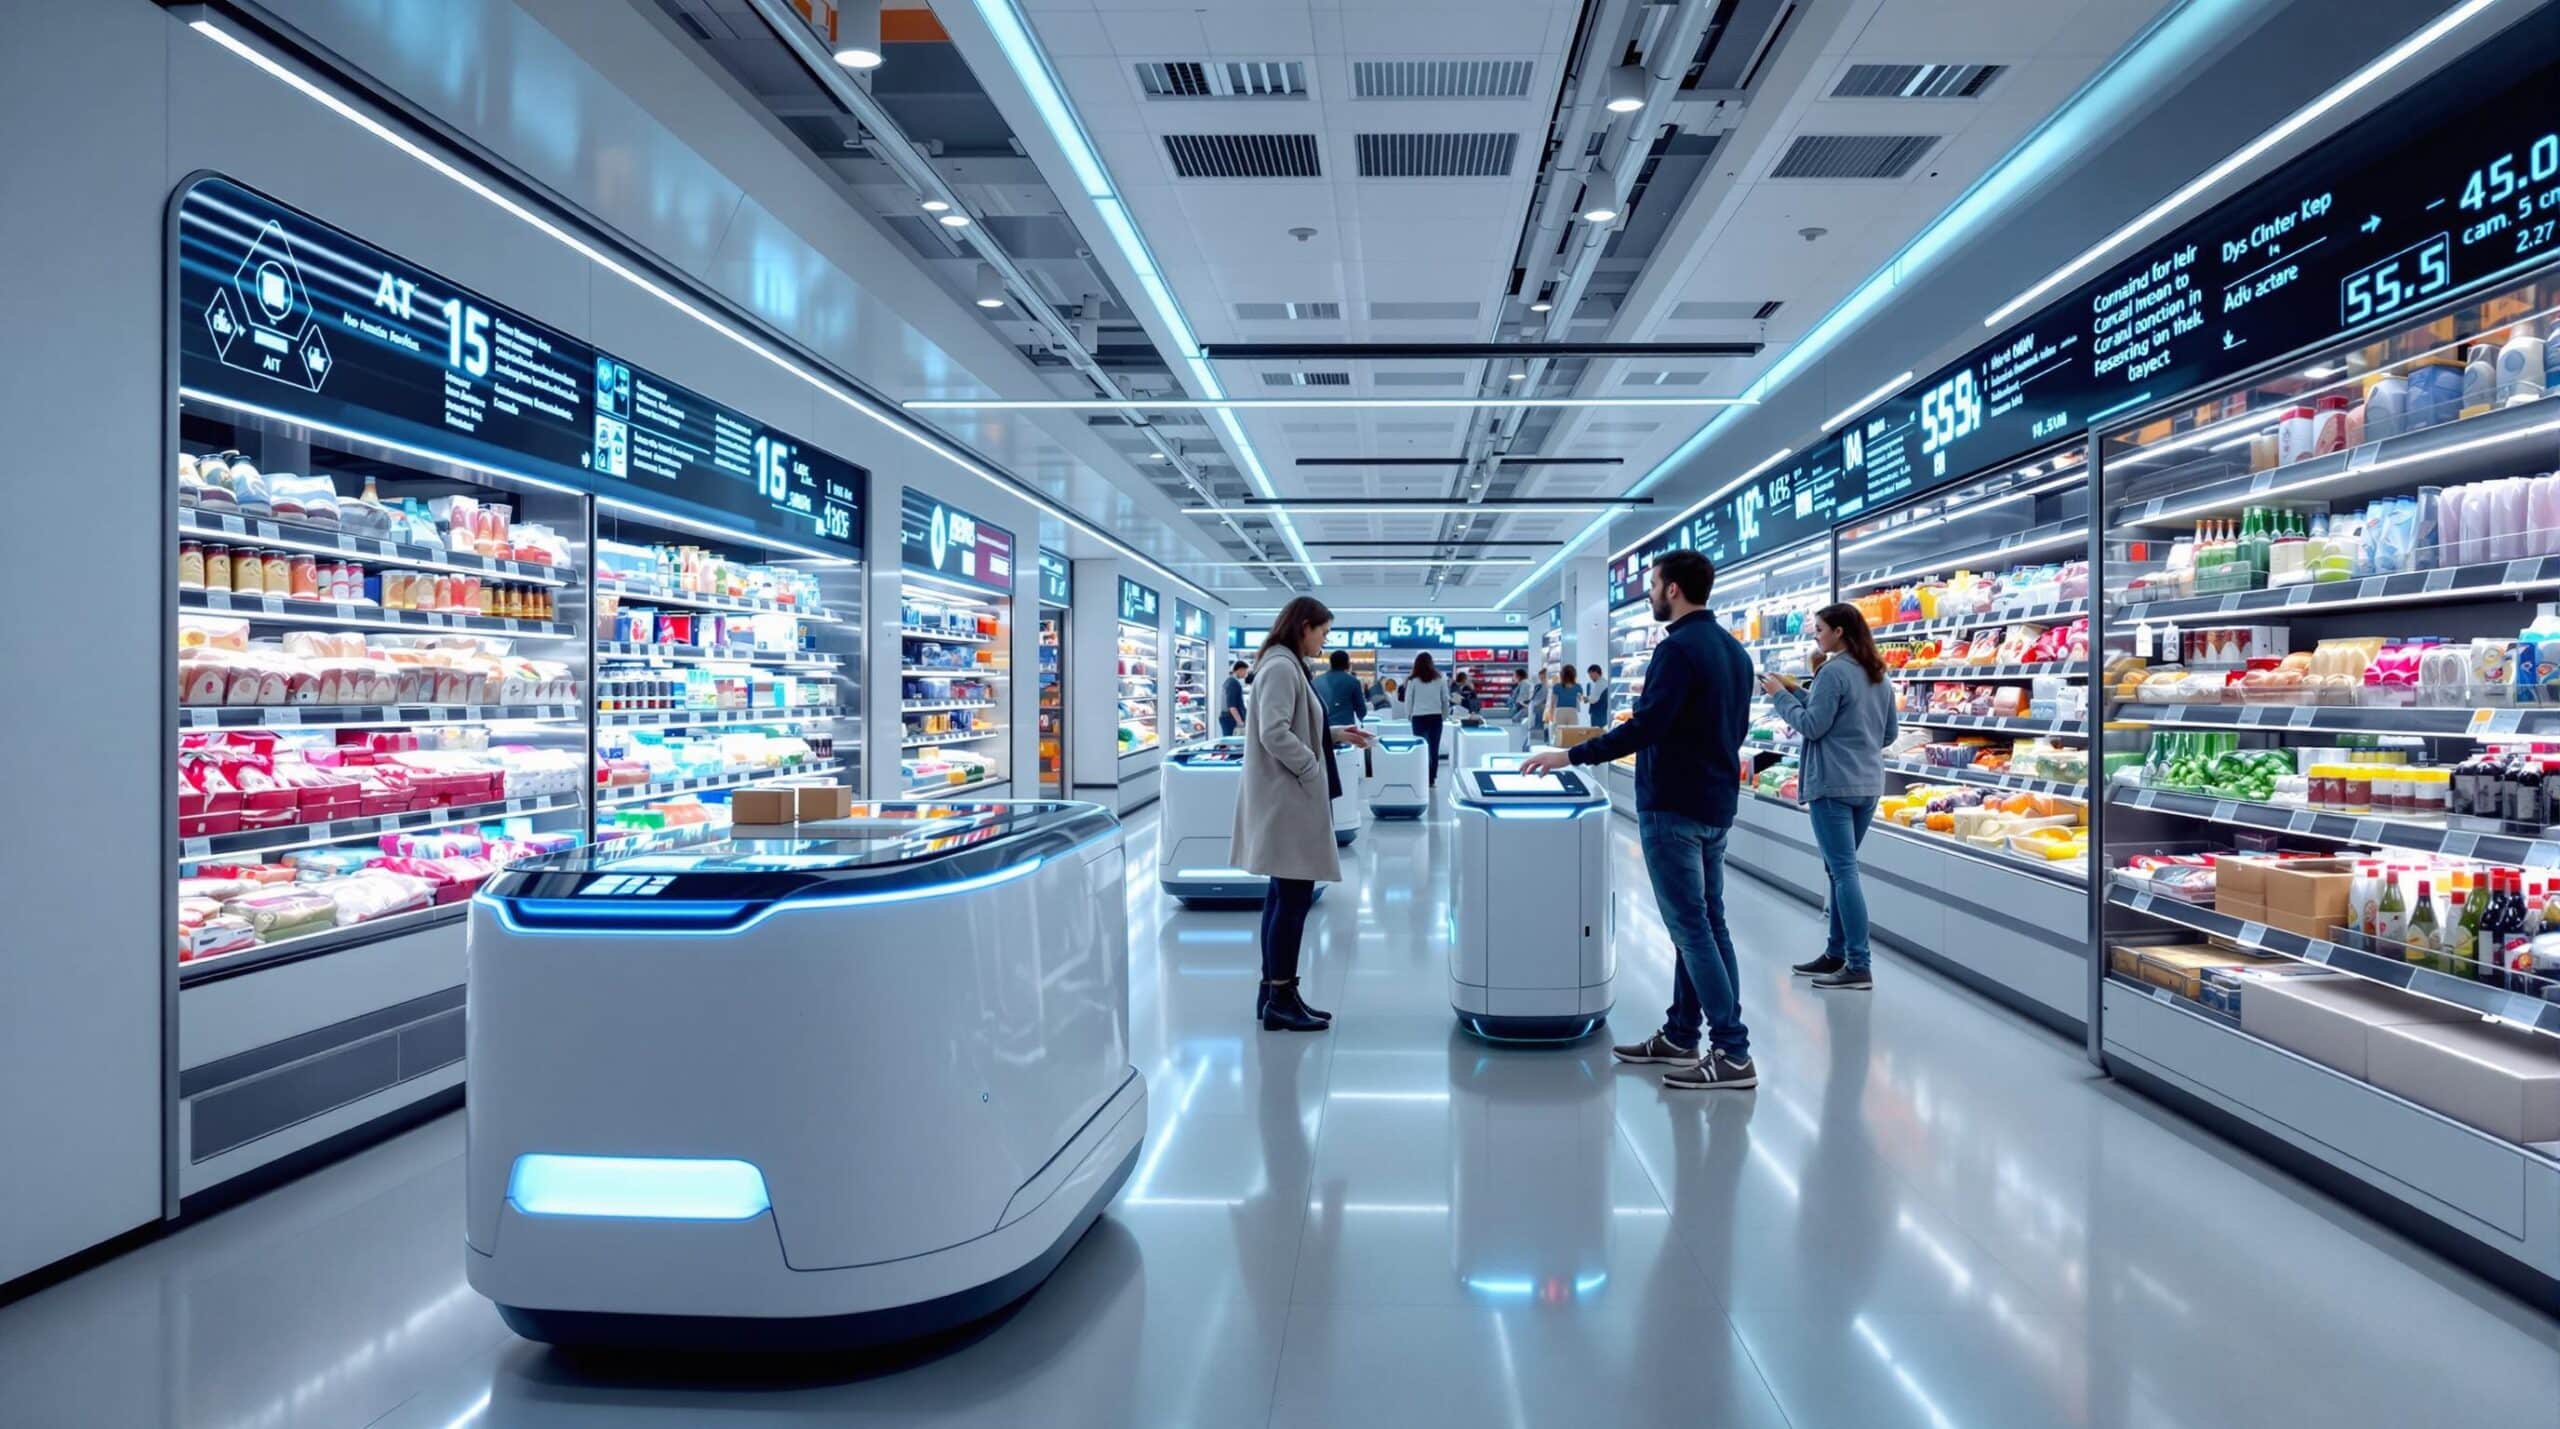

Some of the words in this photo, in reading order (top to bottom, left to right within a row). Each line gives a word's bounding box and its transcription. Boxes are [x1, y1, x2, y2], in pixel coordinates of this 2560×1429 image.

[2519, 195, 2532, 219] 5
[375, 271, 414, 320] AT
[2346, 241, 2446, 324] 55.5
[443, 299, 490, 377] 15
